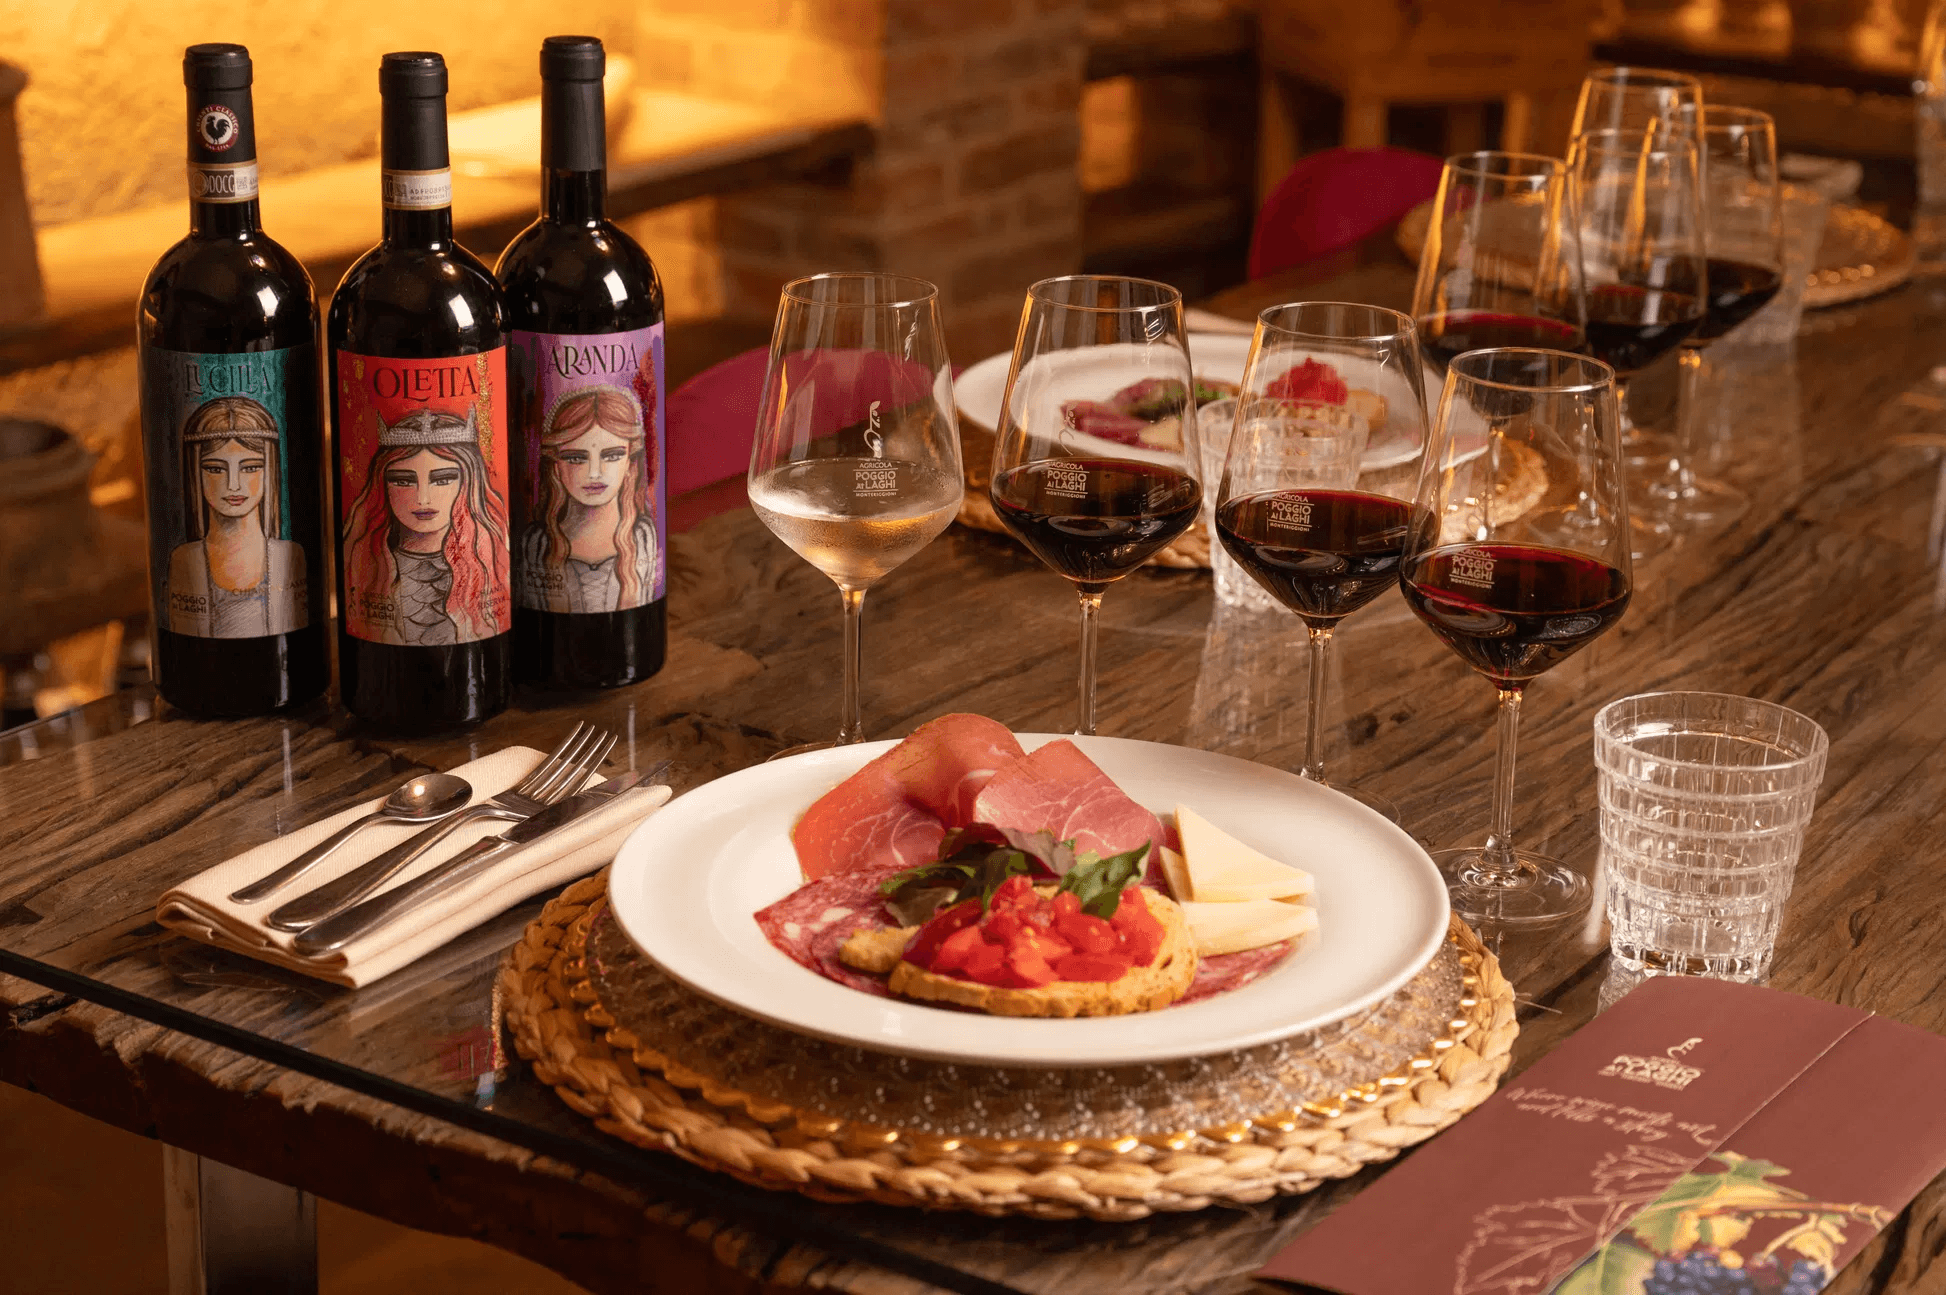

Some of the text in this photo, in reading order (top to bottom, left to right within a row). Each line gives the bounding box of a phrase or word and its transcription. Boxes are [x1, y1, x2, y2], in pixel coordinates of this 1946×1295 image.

[208, 174, 236, 194] DOCG
[547, 342, 641, 380] ARANDA
[373, 365, 478, 402] OLETTA
[1051, 461, 1084, 471] AGRICOLA
[855, 470, 897, 481] POGGIO
[1047, 469, 1087, 483] POGGIO
[865, 479, 896, 490] LAGHI
[1055, 479, 1086, 492] LAGHI
[1271, 500, 1312, 515] POGGIO
[1279, 511, 1311, 525] LAGHI
[1453, 555, 1494, 571] POGGIO
[1460, 566, 1493, 581] LAGHI
[171, 592, 207, 606] POGGIO
[360, 598, 395, 612] POGGIO
[179, 602, 207, 615] LAGHI
[366, 609, 395, 621] LAGHI
